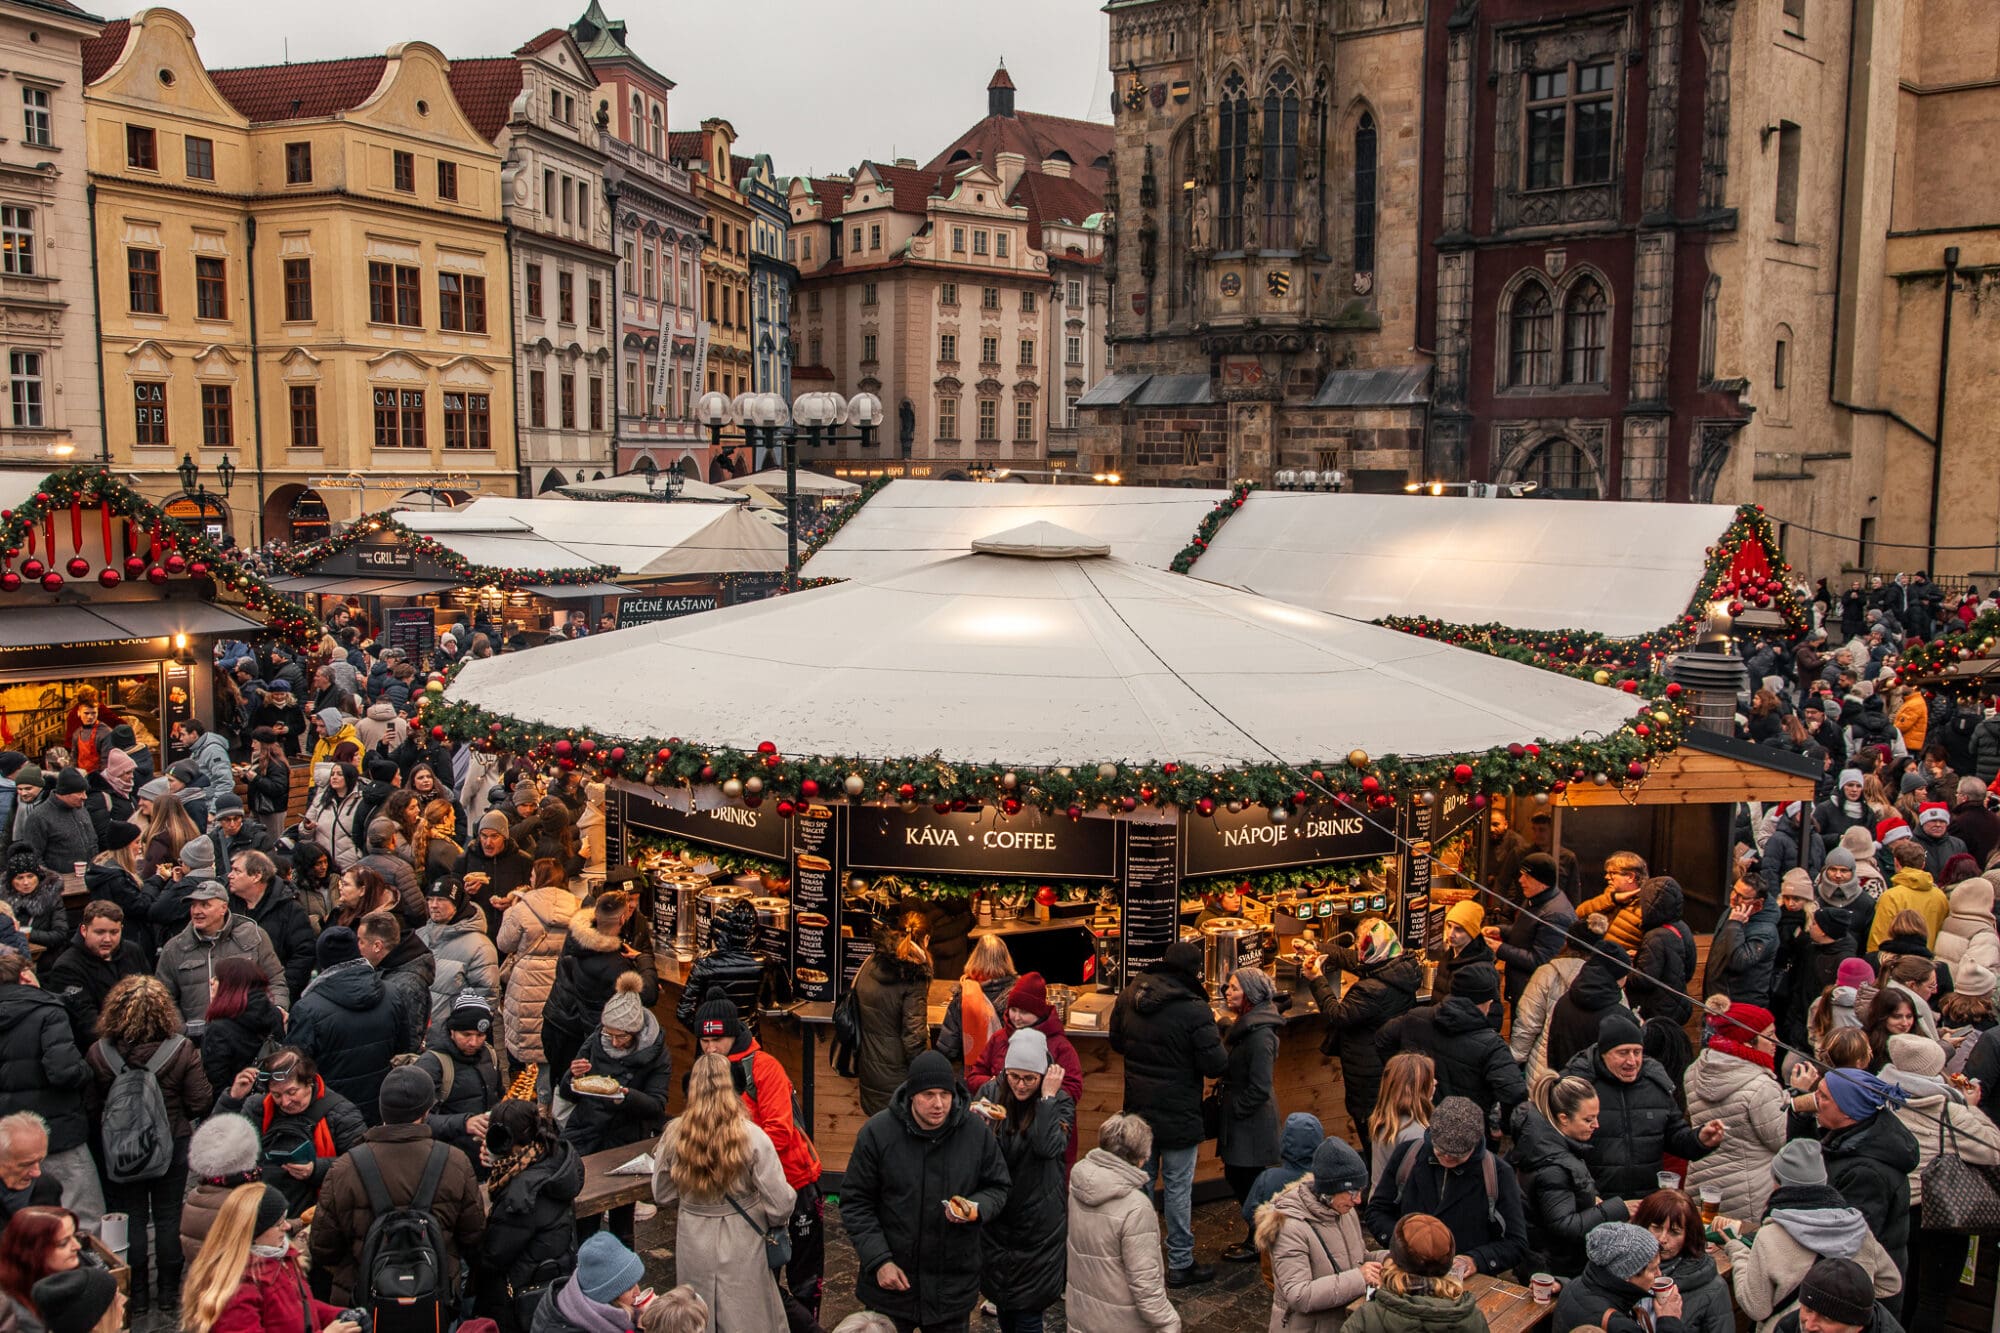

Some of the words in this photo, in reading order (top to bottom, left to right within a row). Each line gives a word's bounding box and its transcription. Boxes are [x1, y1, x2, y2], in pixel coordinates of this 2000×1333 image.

[373, 551, 395, 565] GRIL
[623, 598, 663, 613] PEČENÉ
[666, 597, 715, 611] KAŠTANY
[710, 806, 757, 828] DRINKS
[905, 824, 960, 847] KÁVA
[983, 831, 1057, 850] COFFEE
[1224, 824, 1288, 847] NÁPOJE
[1306, 817, 1364, 838] DRINKS
